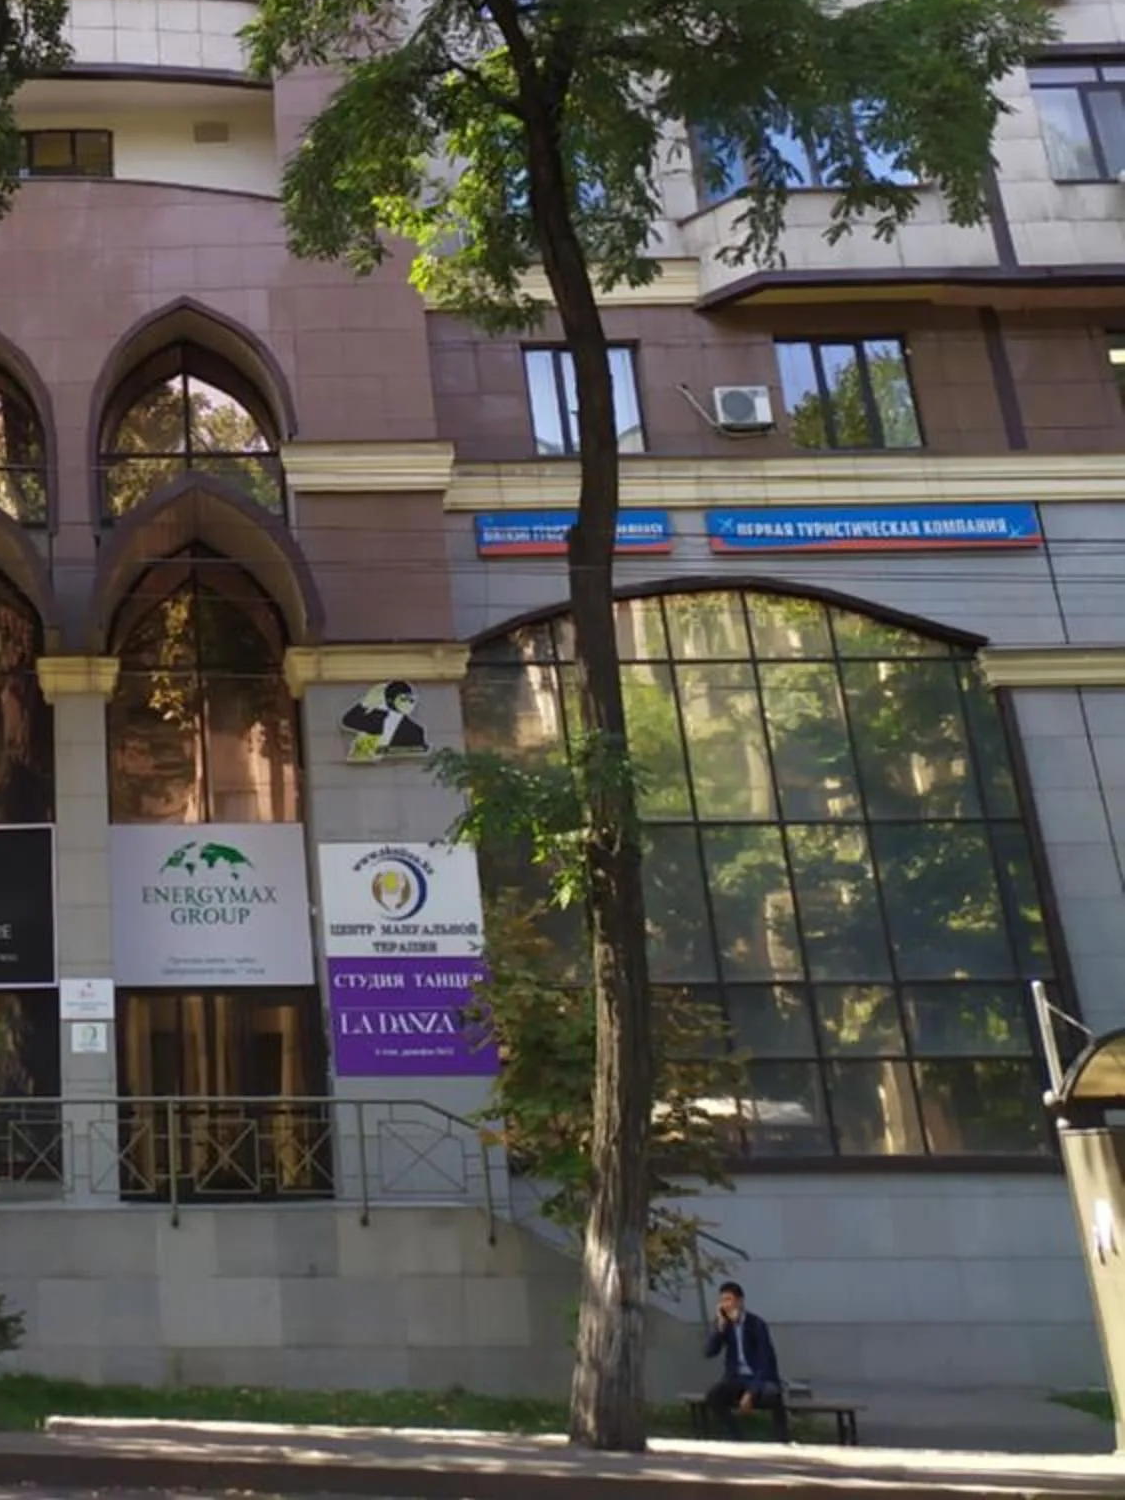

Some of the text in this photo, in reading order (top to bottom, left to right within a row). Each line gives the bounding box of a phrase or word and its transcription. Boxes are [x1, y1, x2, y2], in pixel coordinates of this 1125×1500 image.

[736, 516, 1007, 537] ПЕРВАЯ ТУРИСТИЧЕСКАЯ КОМПАНИЯ
[141, 886, 278, 906] ENERGYMAX
[170, 907, 251, 925] GROUP
[330, 922, 479, 936] ЦЕНТР МАНУАЛЬНОЙ
[373, 940, 437, 953] ТЕРАПИИ
[333, 972, 405, 990] СТУДИЯ
[340, 1011, 455, 1035] LA DANZA
